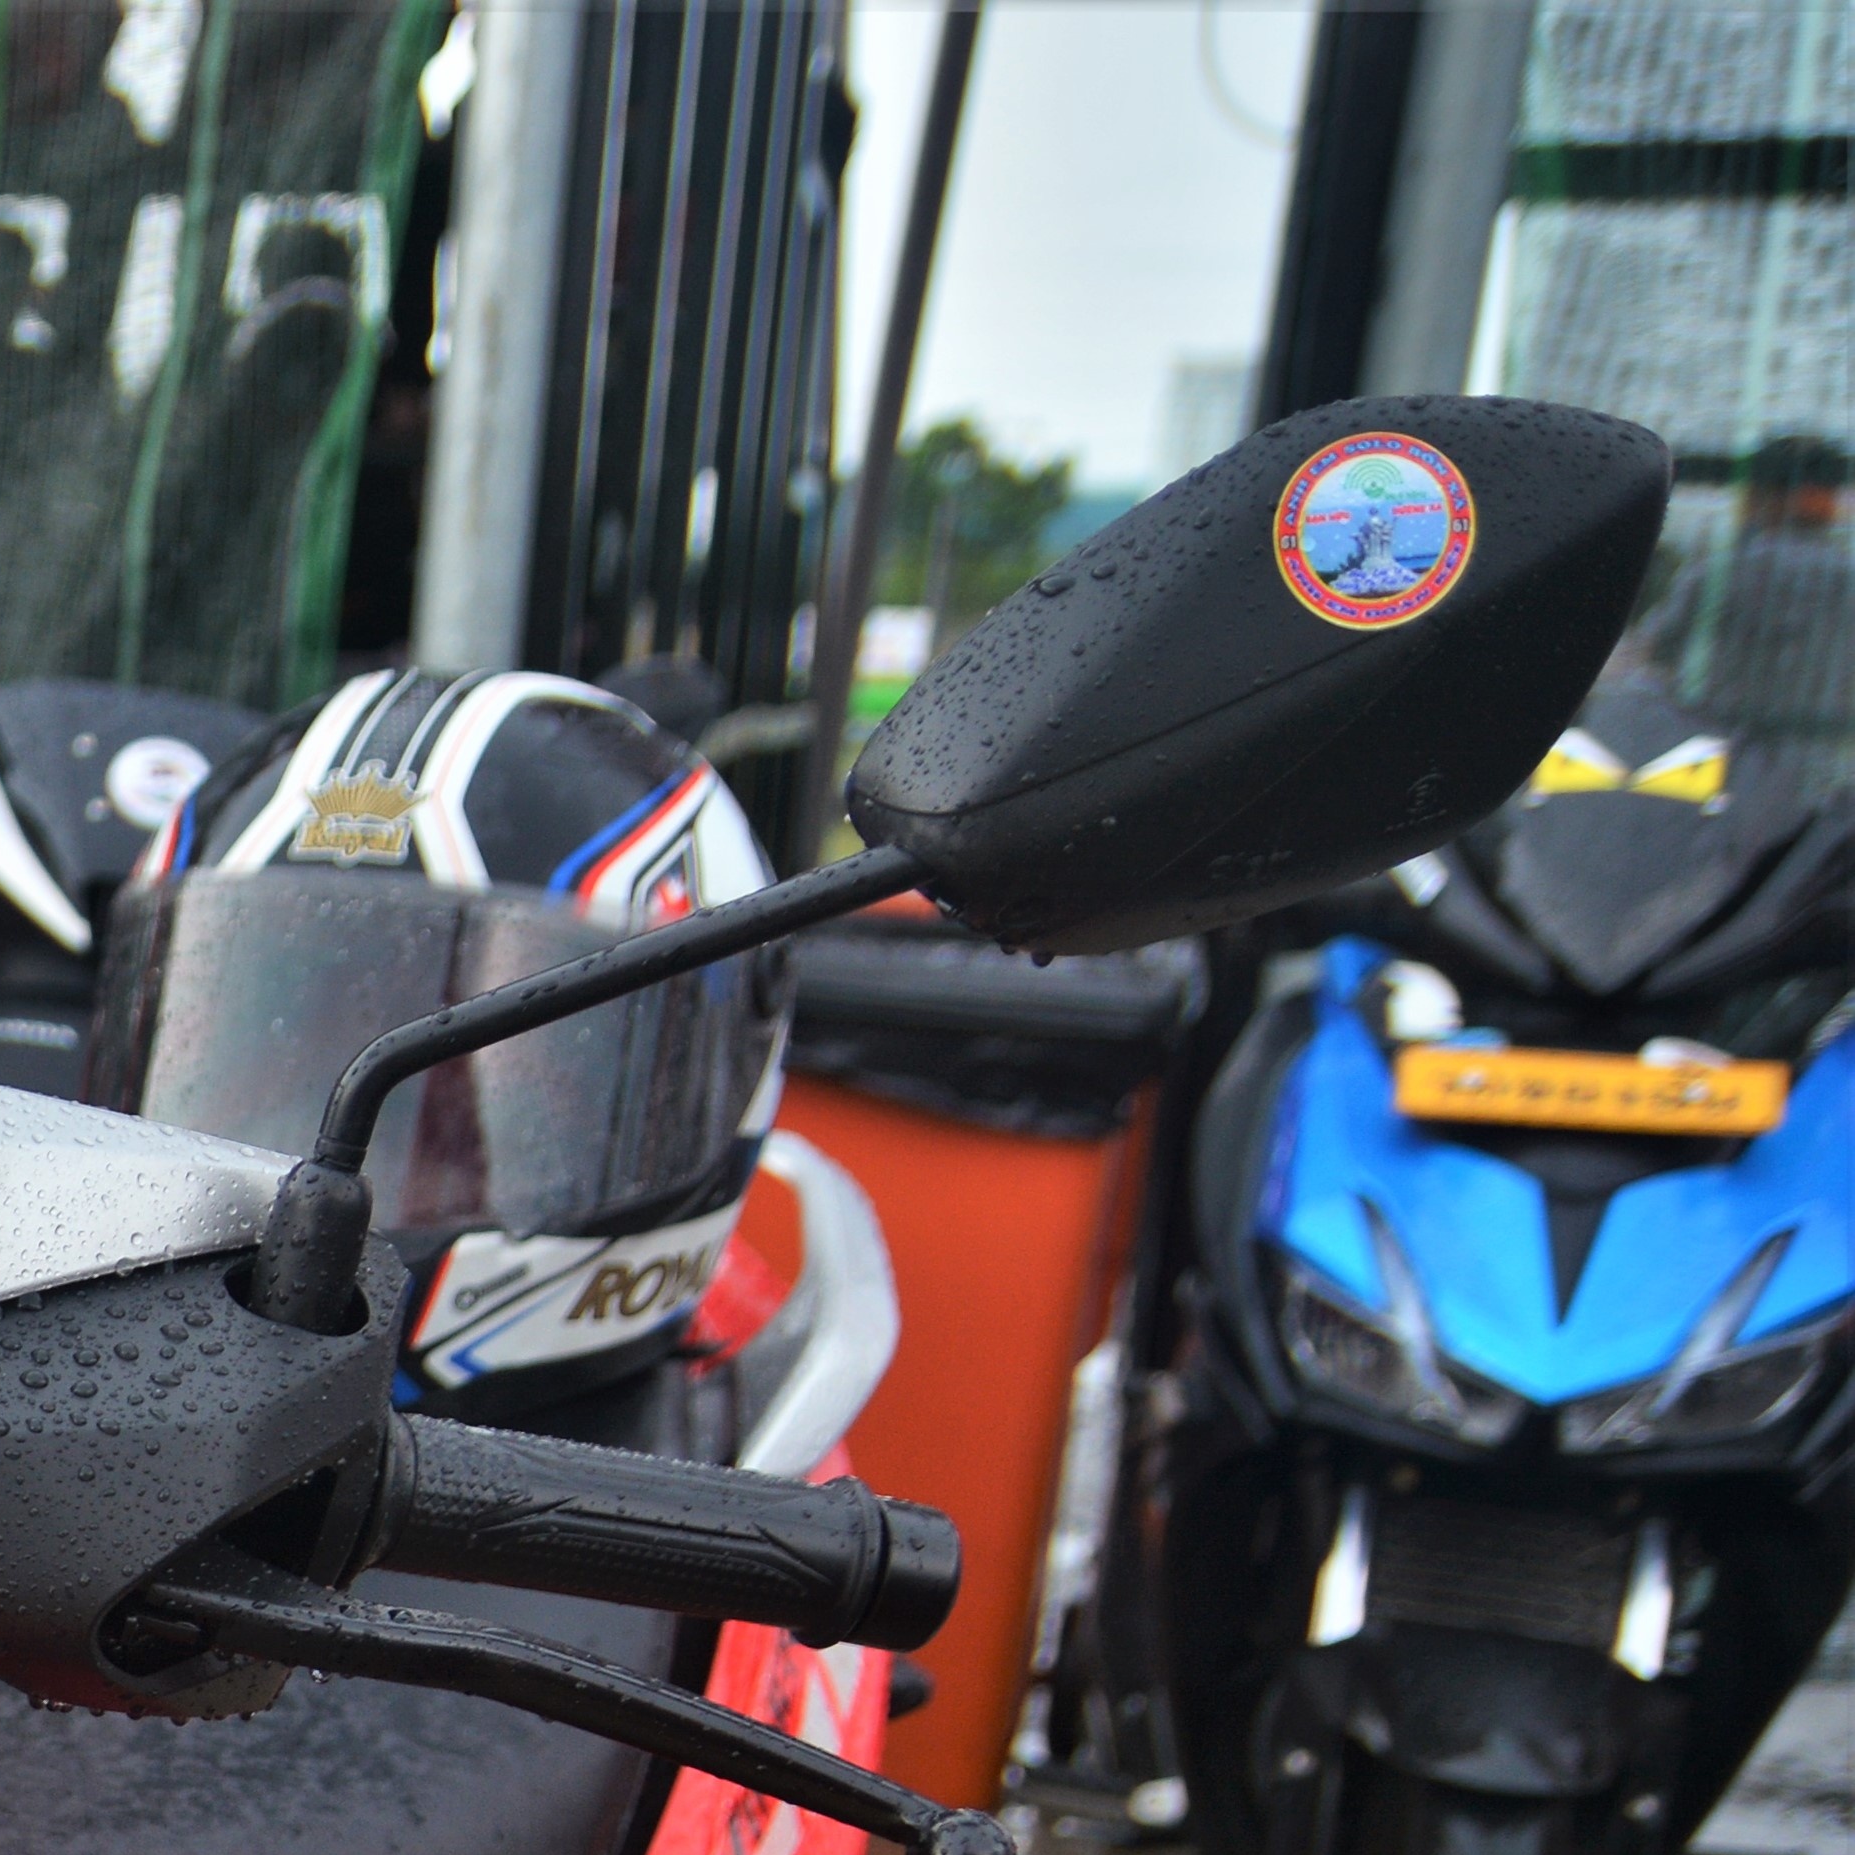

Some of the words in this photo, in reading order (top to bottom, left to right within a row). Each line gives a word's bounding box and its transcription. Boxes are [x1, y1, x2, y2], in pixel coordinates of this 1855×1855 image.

[1285, 479, 1309, 524] ANH
[1310, 452, 1338, 476] EM
[1344, 440, 1402, 454] SOLO
